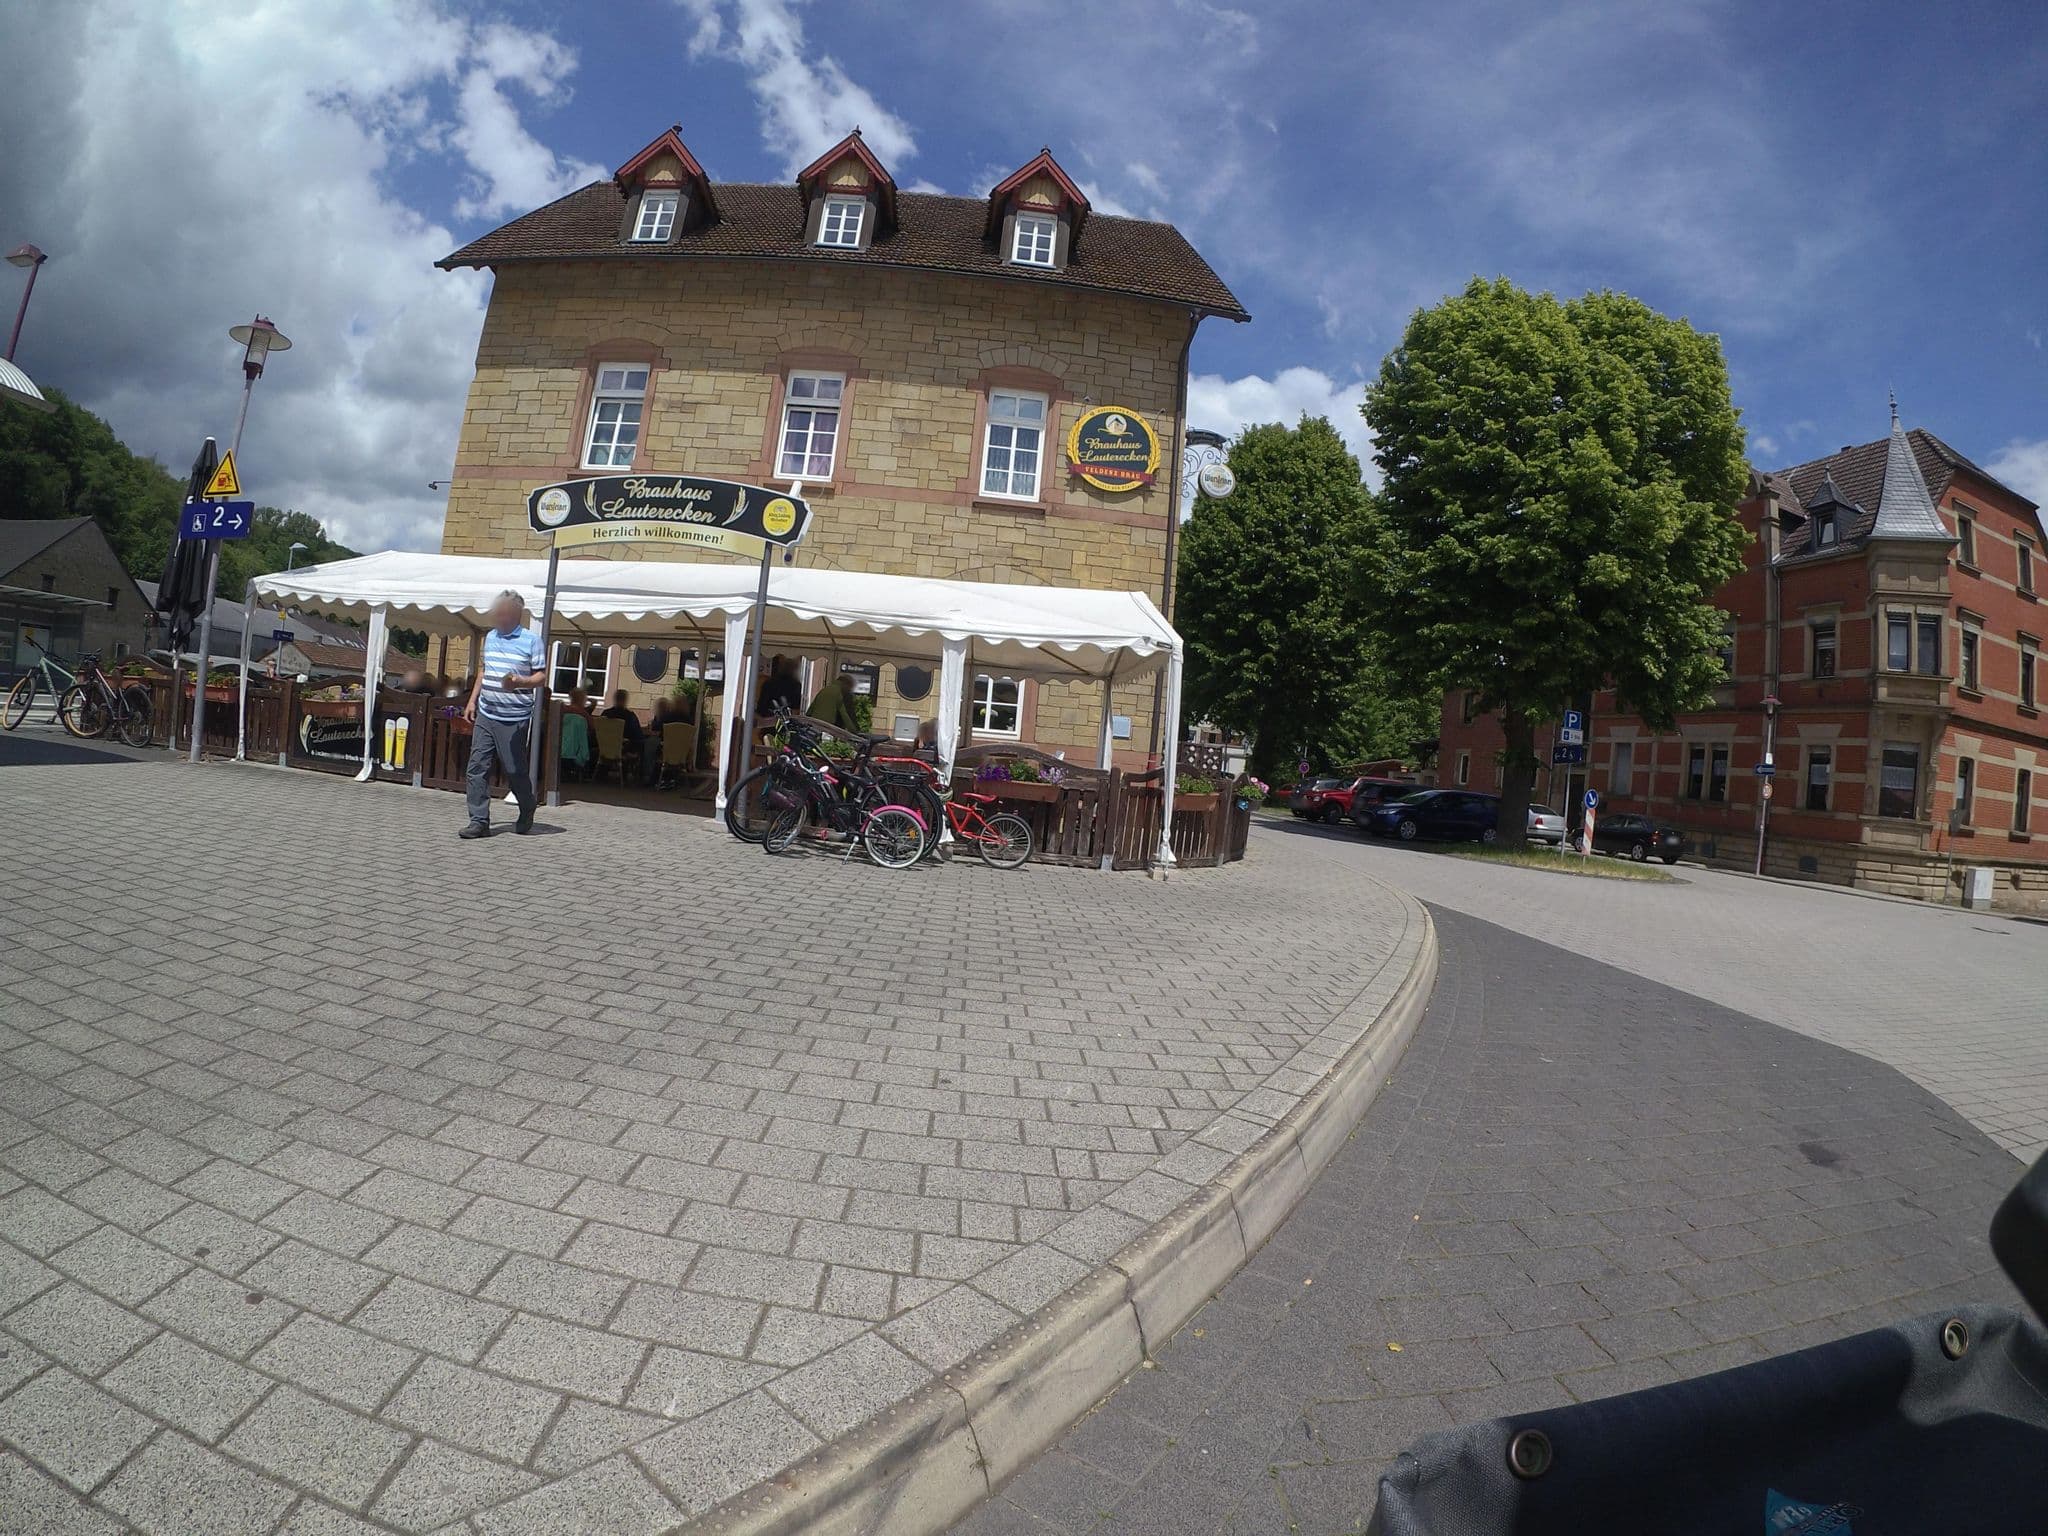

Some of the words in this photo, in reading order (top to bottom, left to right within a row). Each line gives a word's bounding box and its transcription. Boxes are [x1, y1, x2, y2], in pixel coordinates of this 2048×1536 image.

[1085, 437, 1142, 450] Brauhaus
[1079, 450, 1149, 462] Lauterecken
[623, 479, 713, 501] Brauhaus
[213, 506, 225, 526] 2
[601, 498, 717, 523] Lauterecken
[593, 526, 641, 538] Herzlich
[645, 527, 724, 545] willkommen!
[1568, 713, 1578, 727] P
